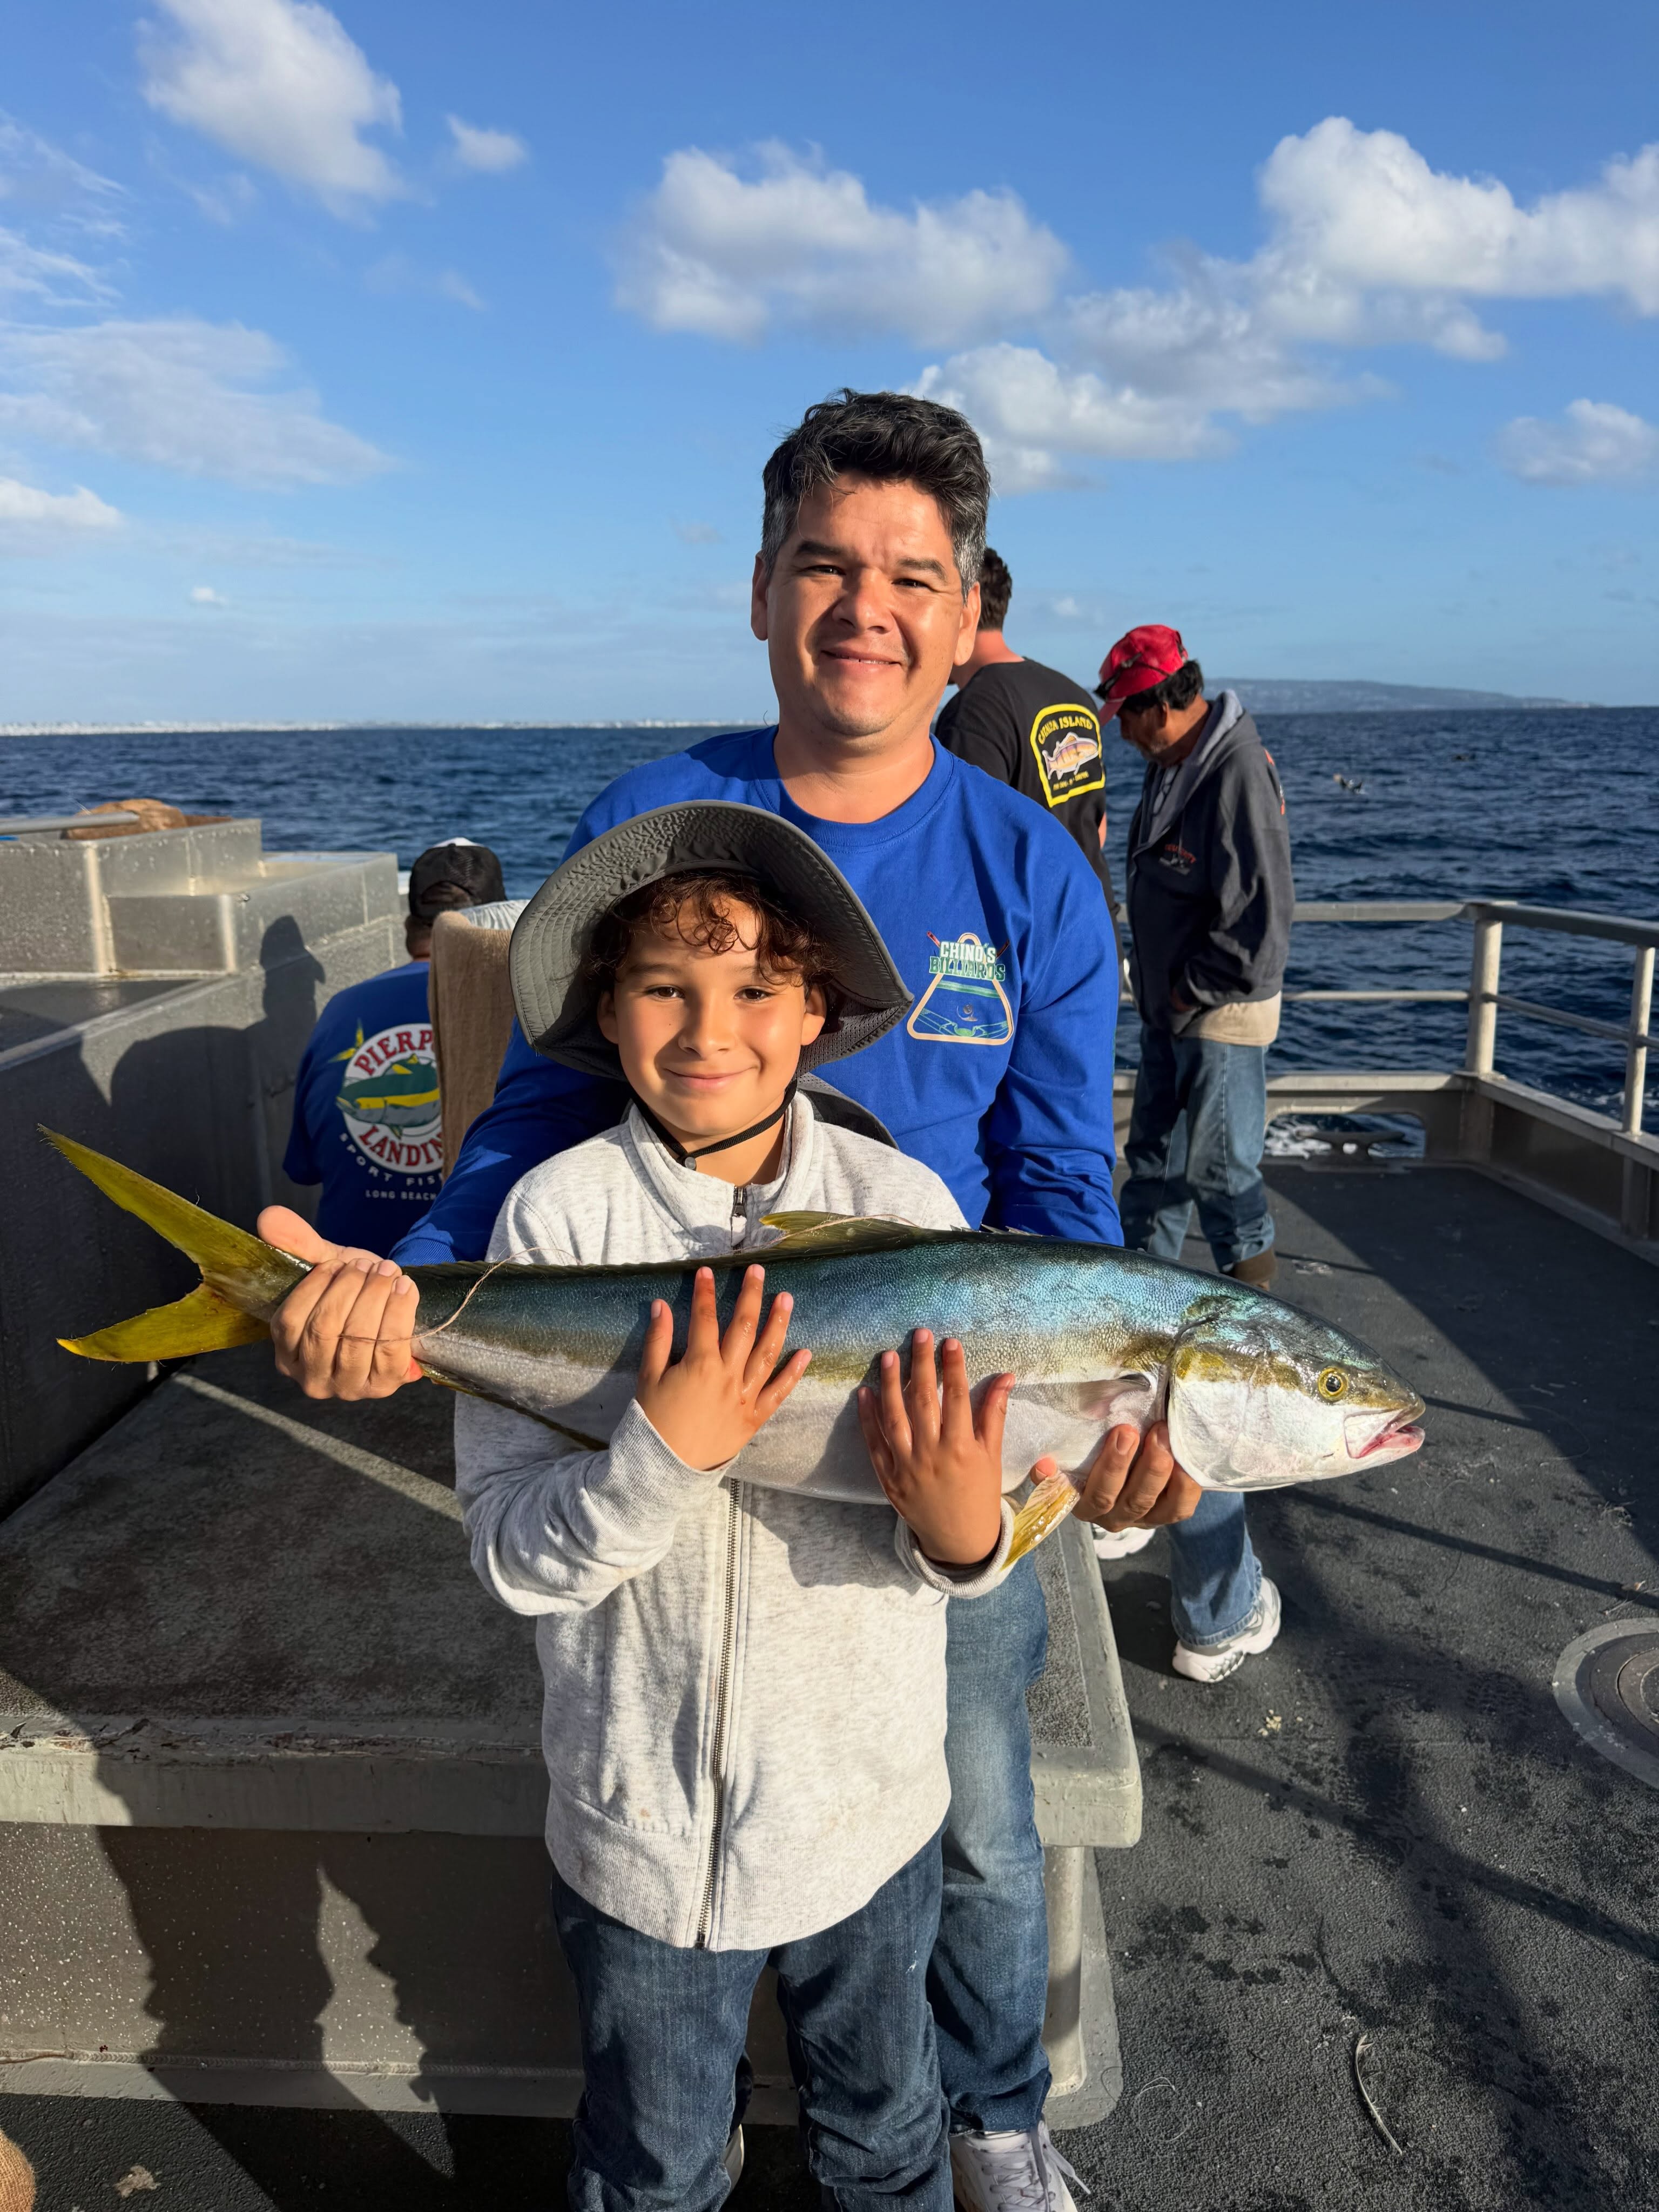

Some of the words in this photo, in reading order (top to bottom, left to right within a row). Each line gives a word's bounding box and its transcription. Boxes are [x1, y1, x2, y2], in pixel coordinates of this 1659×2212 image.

[1058, 716, 1093, 730] ISLAND
[940, 941, 996, 963] CHINO'S
[929, 956, 1006, 982] BILLIARDS
[354, 1029, 434, 1076] PIERP
[339, 1132, 393, 1182] SPORT
[365, 1189, 396, 1200] LONG
[400, 1190, 437, 1202] BEACH
